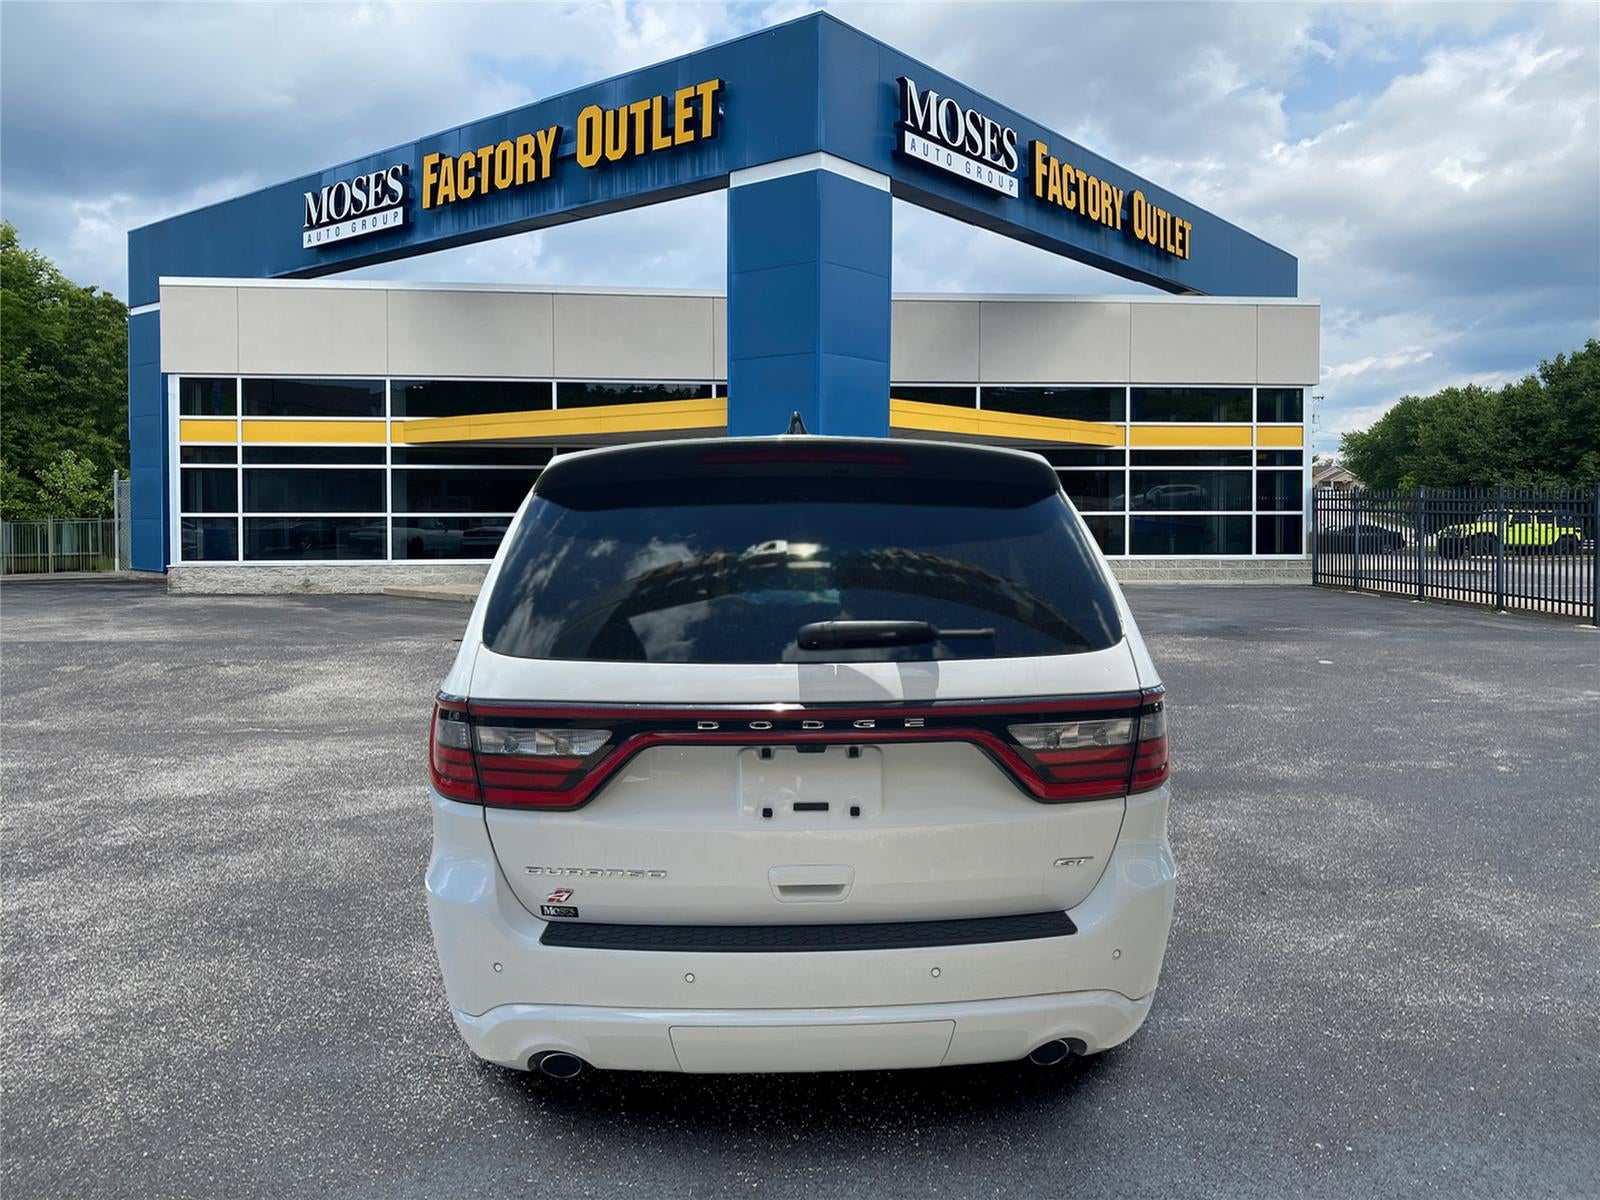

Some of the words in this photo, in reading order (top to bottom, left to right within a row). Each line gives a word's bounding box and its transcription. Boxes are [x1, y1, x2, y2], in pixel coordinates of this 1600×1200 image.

[422, 125, 559, 208] FACTORY
[577, 79, 719, 168] OUTLET
[904, 77, 1018, 172] MOSES
[909, 137, 953, 167] AUTO
[965, 161, 1014, 193] GROUP
[303, 164, 403, 227] MOSES
[1034, 140, 1123, 230] FACTORY
[1132, 190, 1192, 259] OUTLET
[307, 226, 340, 244] AUTO
[351, 211, 399, 233] GROUP
[697, 718, 925, 730] DODGE
[524, 866, 668, 879] DURANGO
[1053, 856, 1094, 867] GT
